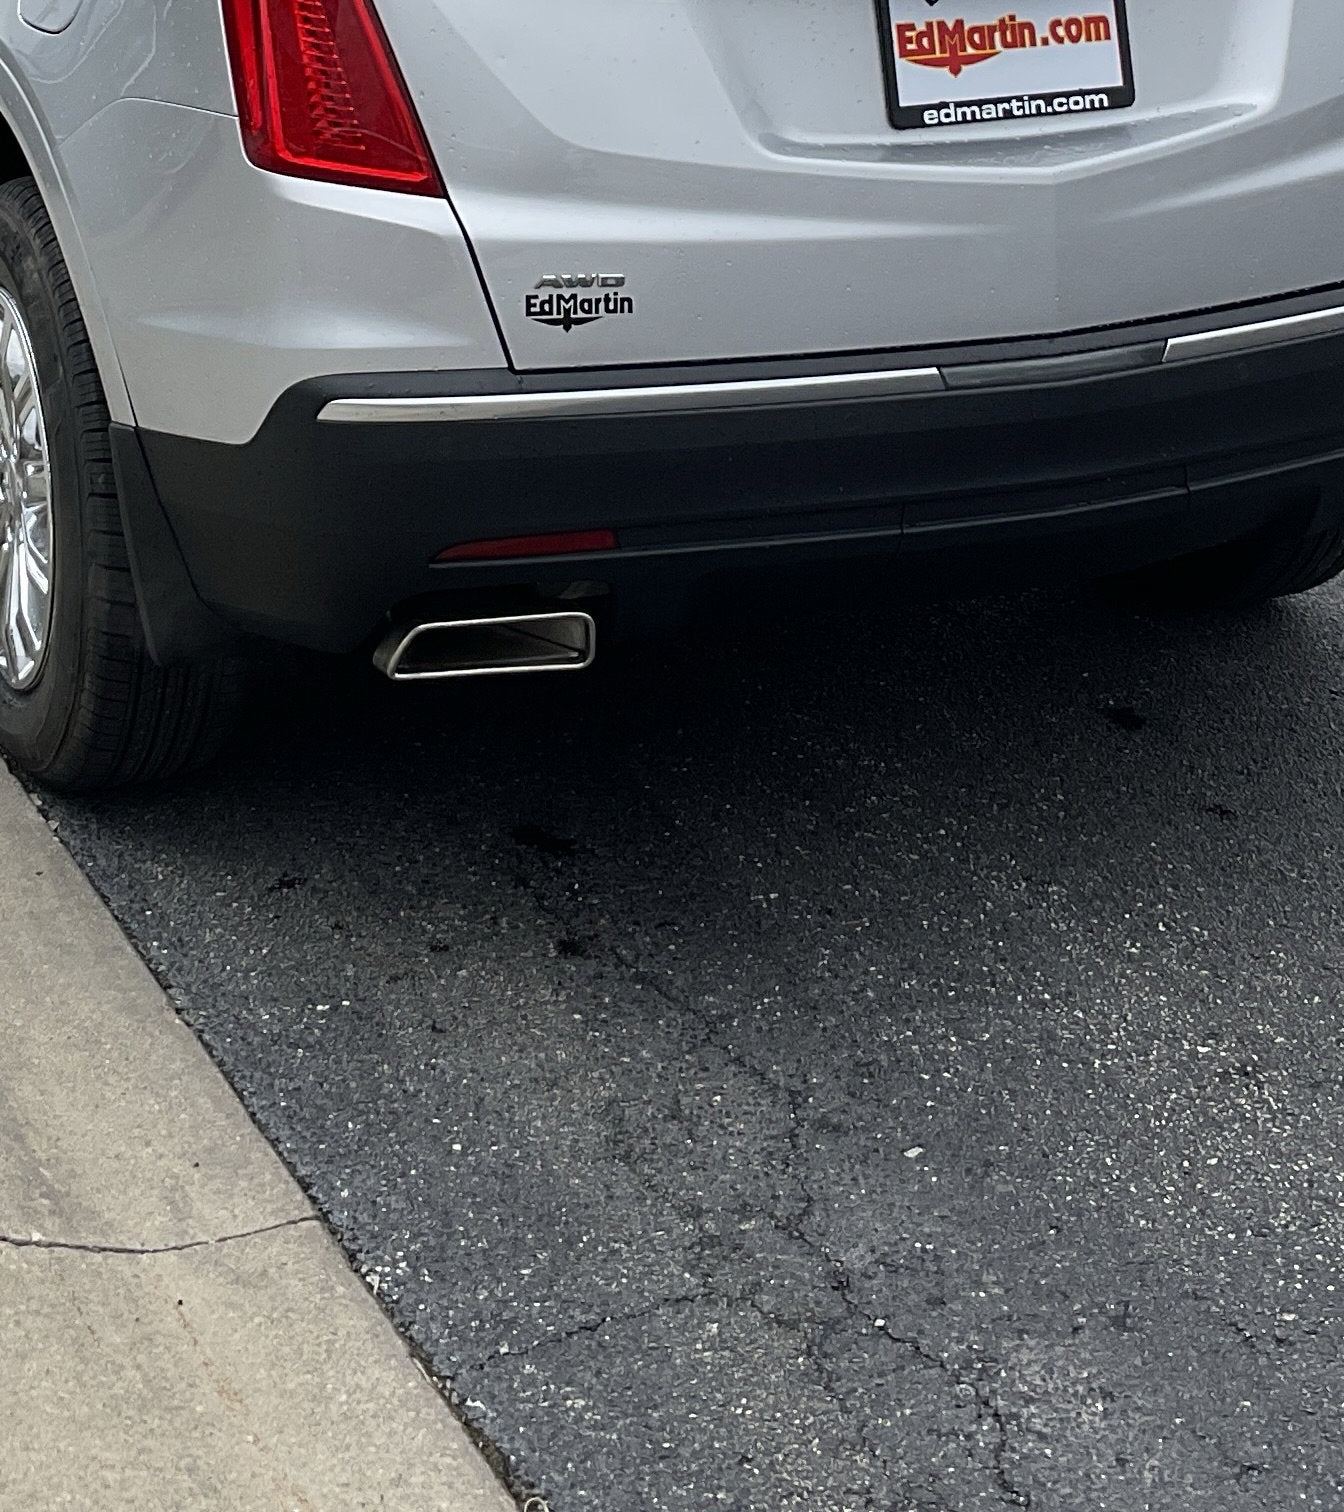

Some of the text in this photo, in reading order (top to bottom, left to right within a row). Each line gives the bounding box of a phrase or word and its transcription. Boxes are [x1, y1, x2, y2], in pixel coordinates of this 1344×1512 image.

[895, 13, 1112, 60] EdMartin.com
[922, 92, 1109, 126] edmartin.com
[534, 273, 626, 289] AWD
[524, 291, 634, 319] EdMartin
